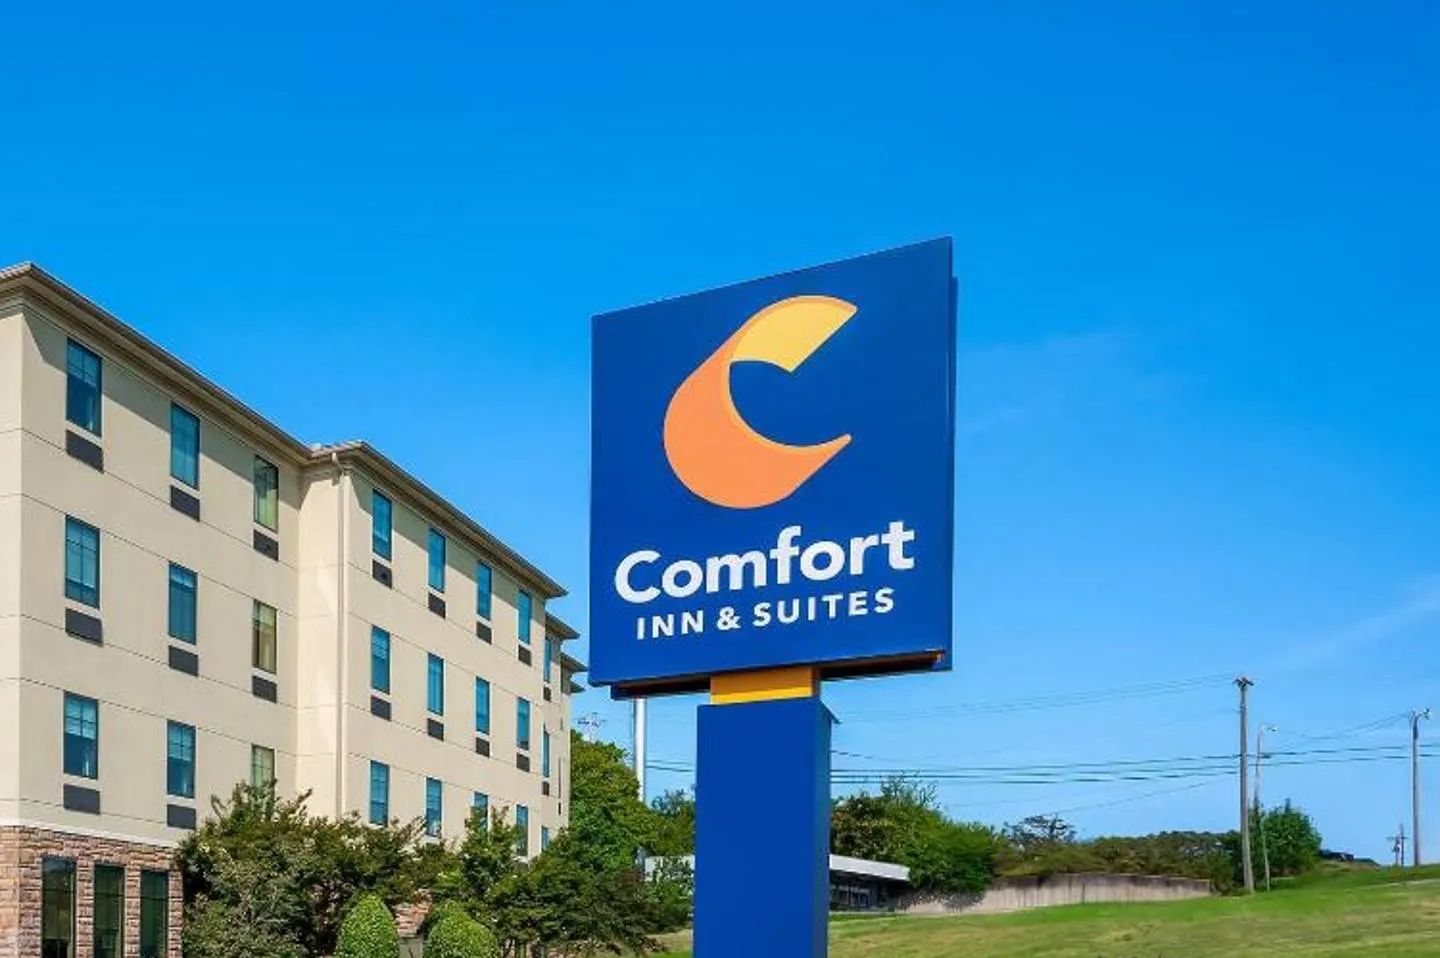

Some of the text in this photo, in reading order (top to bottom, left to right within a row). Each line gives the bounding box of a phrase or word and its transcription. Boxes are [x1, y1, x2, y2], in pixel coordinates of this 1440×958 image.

[614, 521, 916, 604] Comfort
[636, 588, 896, 640] INN & SUITES
